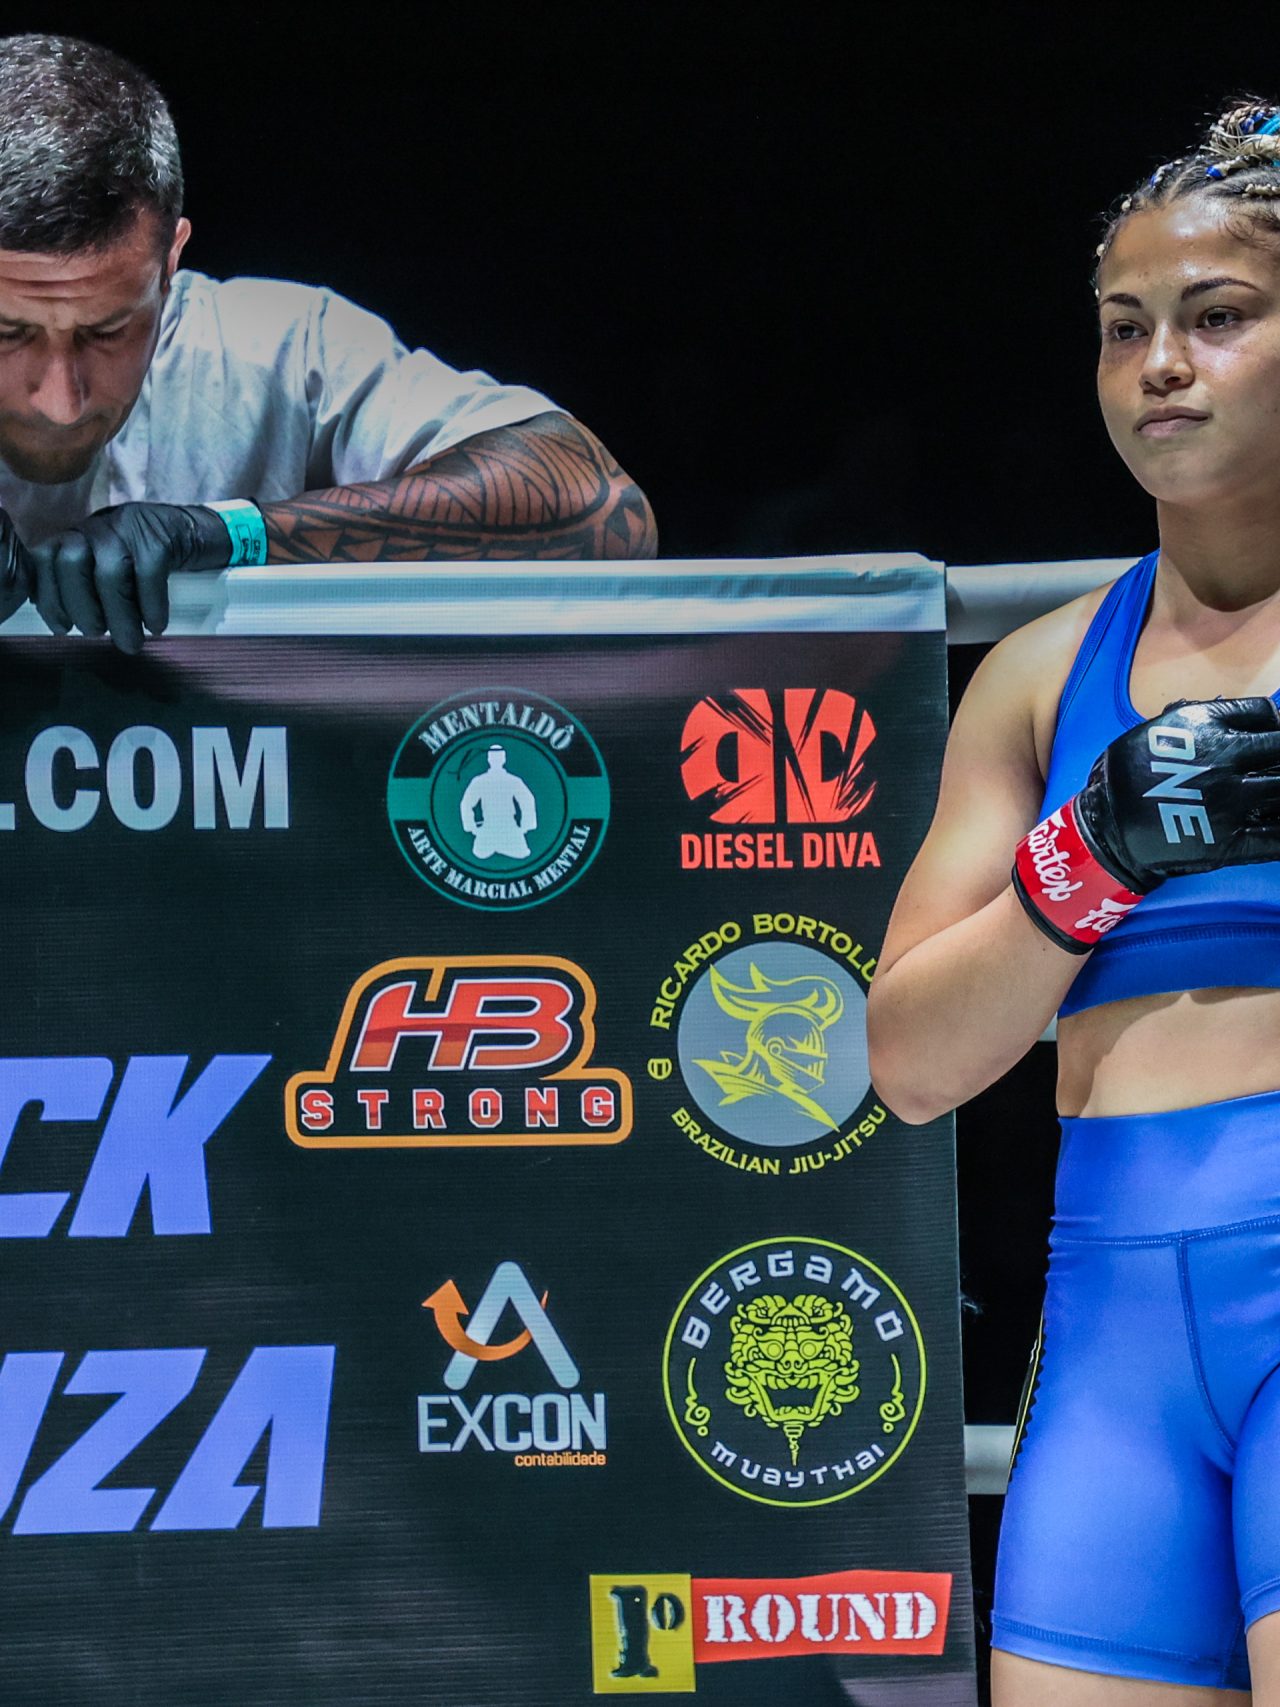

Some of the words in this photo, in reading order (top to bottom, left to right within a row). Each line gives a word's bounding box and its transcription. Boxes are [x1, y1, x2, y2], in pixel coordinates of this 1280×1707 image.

[417, 700, 576, 756] MENTALDÔ
[1142, 725, 1214, 845] ONE
[408, 825, 446, 877] ARTE
[445, 868, 534, 899] MARCIAL
[532, 822, 592, 891] MENTAL
[681, 833, 794, 869] DIESEL
[803, 831, 881, 868] DIVA
[650, 921, 742, 1031] RICARDO
[349, 977, 574, 1072] HB
[300, 1085, 616, 1131] STRONG
[671, 1106, 781, 1176] BRAZILIAN
[788, 1104, 888, 1175] JIU-JITSU
[417, 1392, 608, 1454] EXCON
[514, 1451, 607, 1468] contabilidade
[703, 1592, 938, 1643] ROUND
